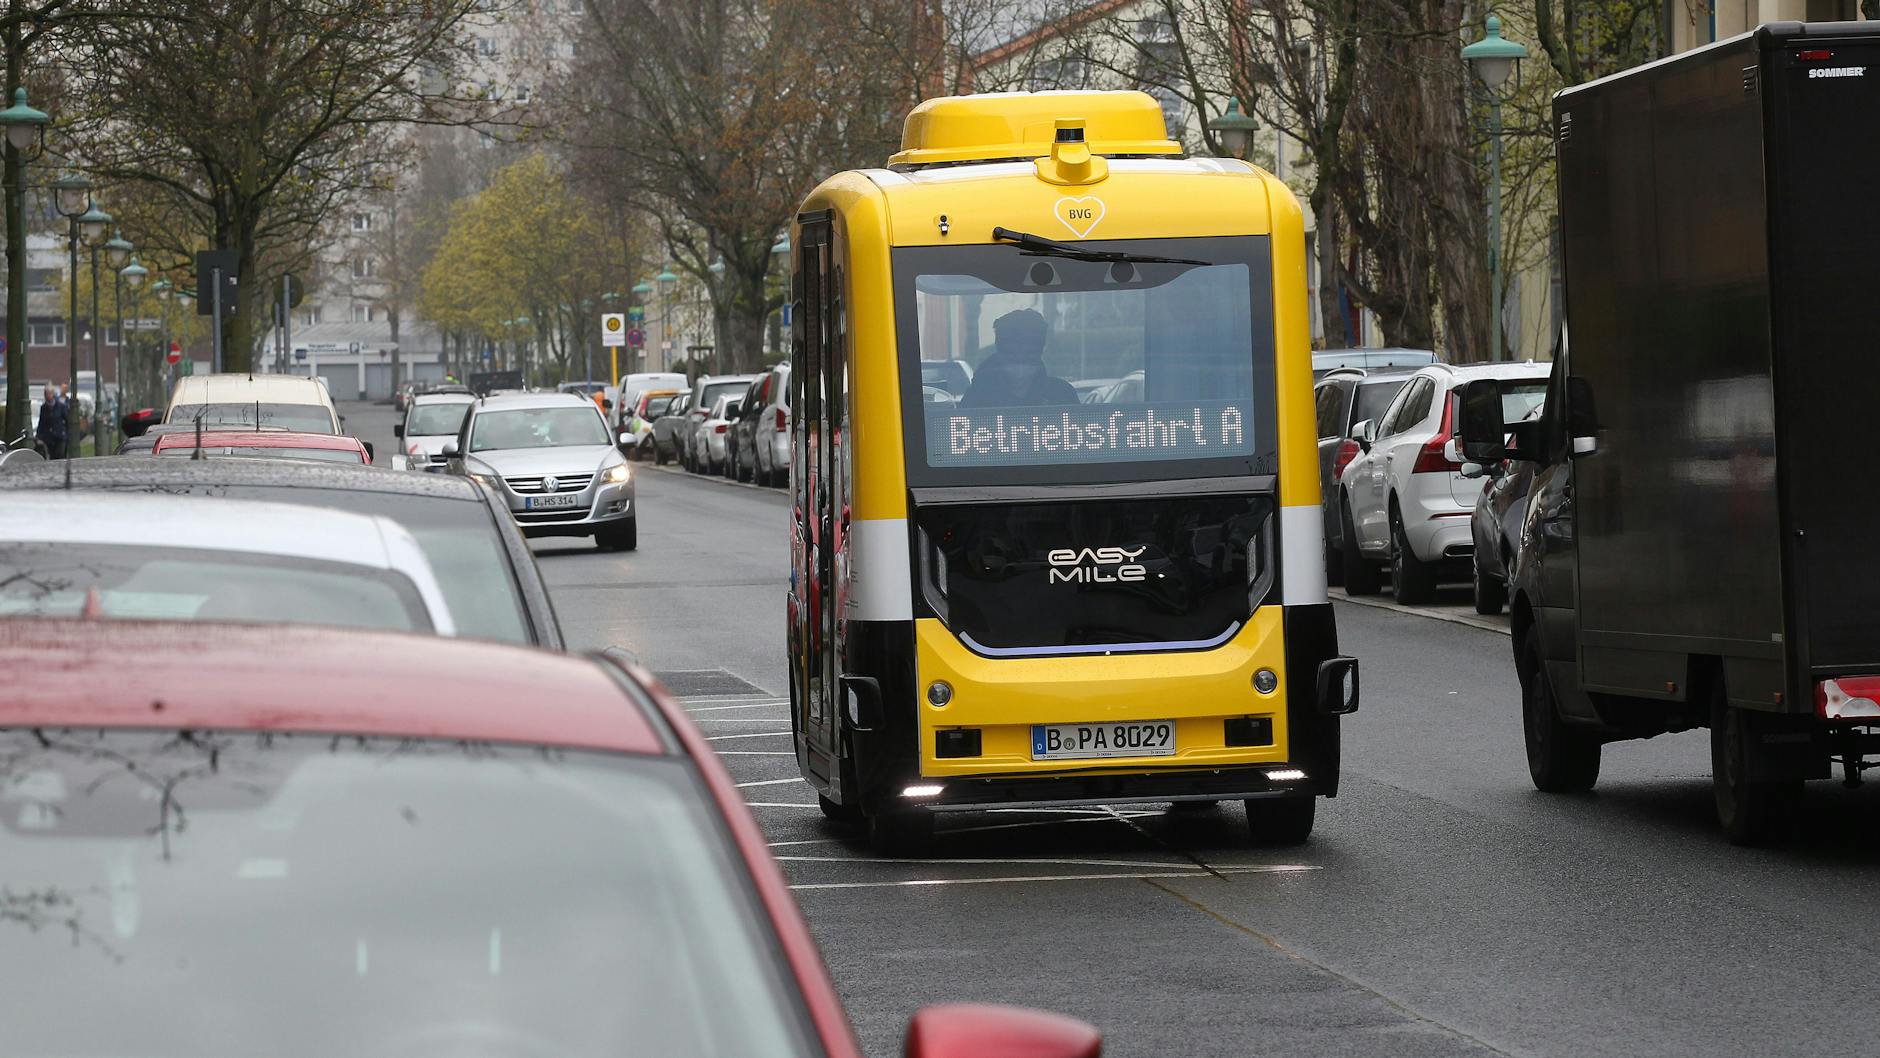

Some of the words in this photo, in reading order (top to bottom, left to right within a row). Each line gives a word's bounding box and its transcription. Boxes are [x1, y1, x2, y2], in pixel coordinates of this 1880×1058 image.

[1808, 66, 1864, 79] SOMMER
[1069, 208, 1092, 220] BVG
[949, 407, 1207, 454] Betriebsfahrt
[1221, 406, 1243, 445] A
[533, 498, 540, 507] B
[544, 497, 556, 506] HS
[557, 496, 574, 505] 314
[1047, 728, 1062, 751] B
[1078, 727, 1108, 750] PA
[1113, 724, 1170, 748] 8029
